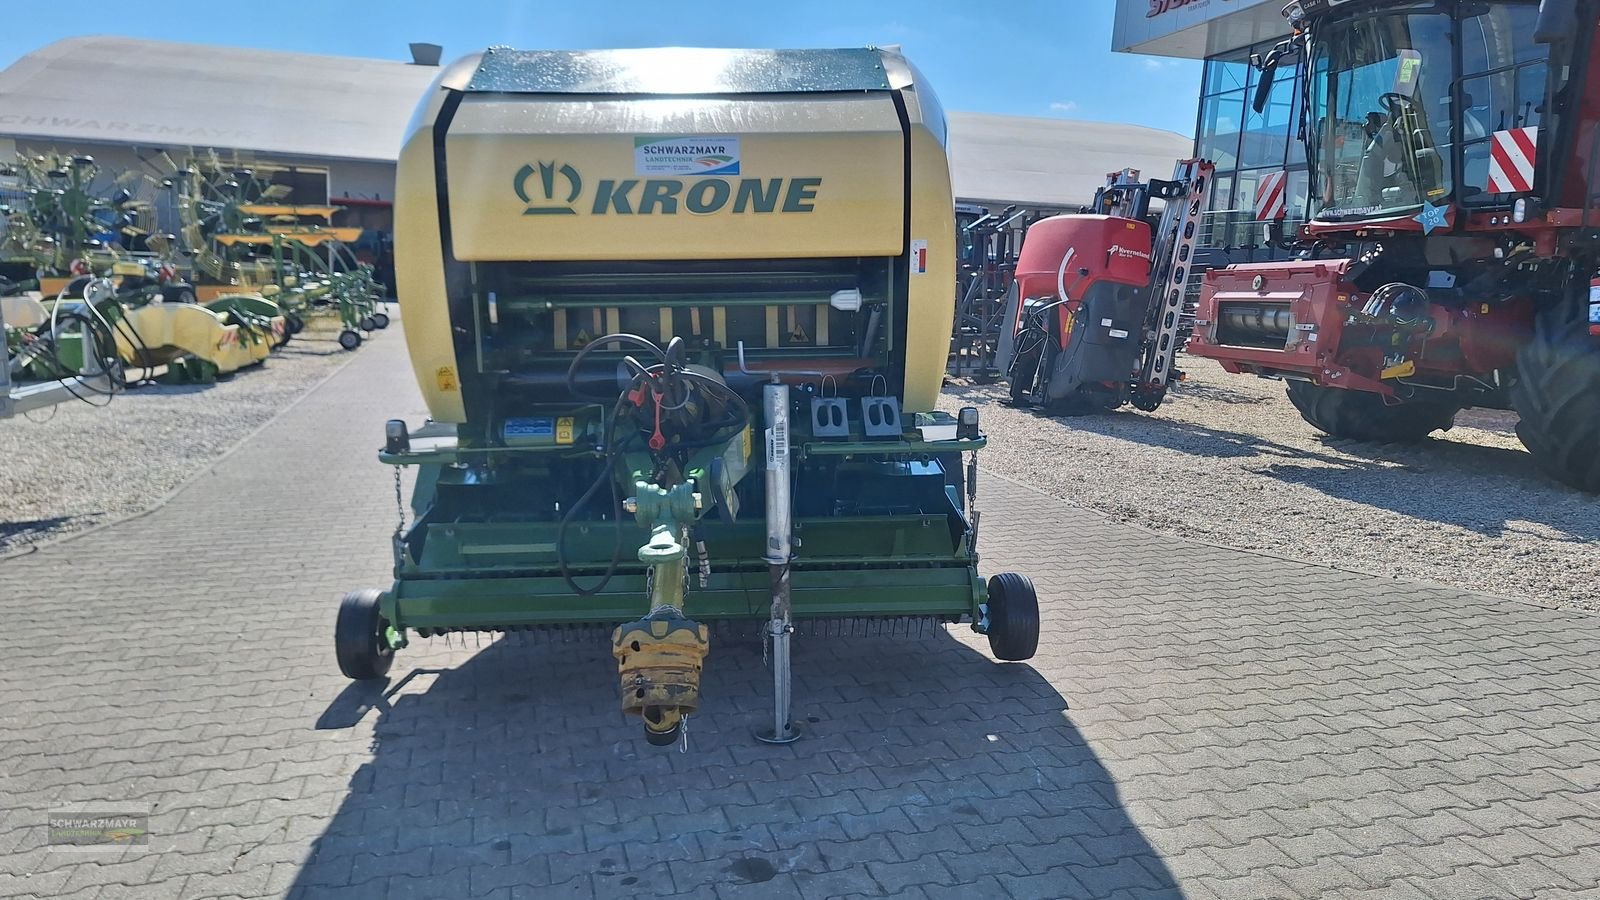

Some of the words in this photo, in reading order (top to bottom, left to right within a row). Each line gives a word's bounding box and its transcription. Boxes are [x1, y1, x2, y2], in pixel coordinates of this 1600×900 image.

[0, 114, 252, 137] CHWARZMAYR
[643, 145, 726, 154] SCHWARZMAYR
[591, 177, 823, 215] KRONE
[1422, 208, 1440, 218] TOP
[1428, 217, 1440, 226] 20
[1118, 246, 1150, 259] Kverneland
